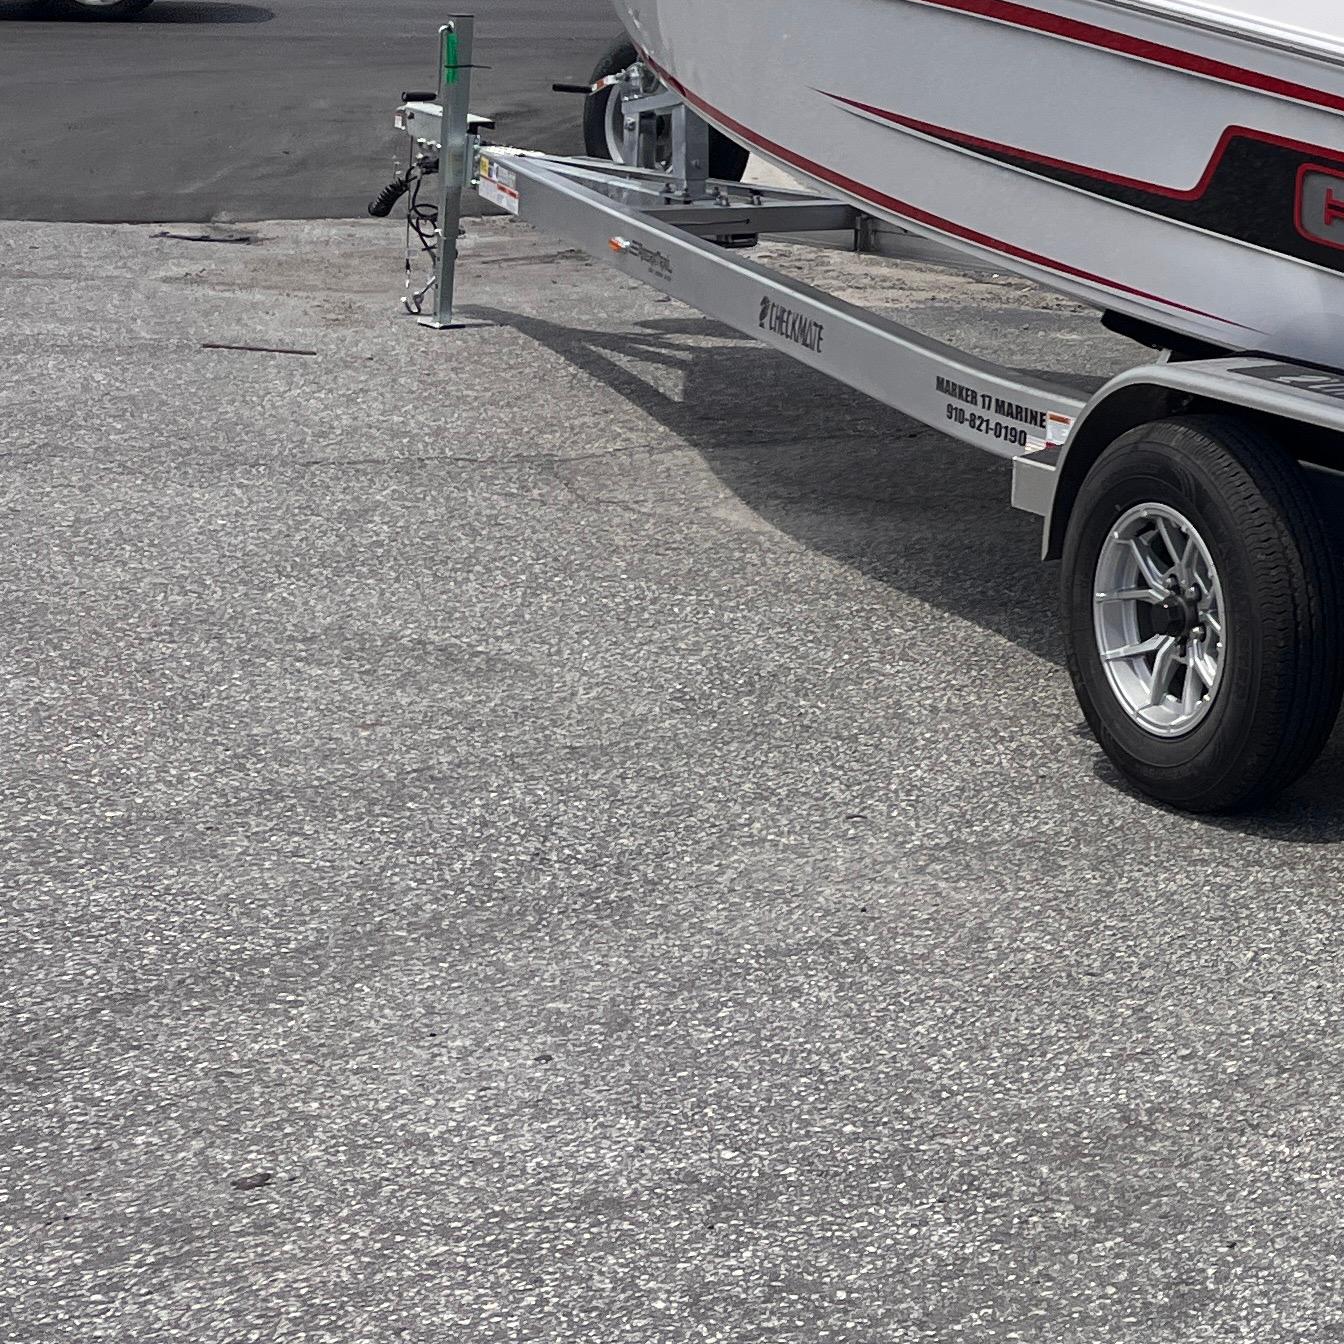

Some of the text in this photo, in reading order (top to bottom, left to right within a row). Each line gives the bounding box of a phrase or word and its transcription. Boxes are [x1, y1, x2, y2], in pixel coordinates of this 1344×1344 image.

[935, 375, 979, 406] MARKER
[980, 393, 993, 411] 17
[994, 398, 1048, 429] MARINE
[946, 403, 1028, 447] 910-821-0190
